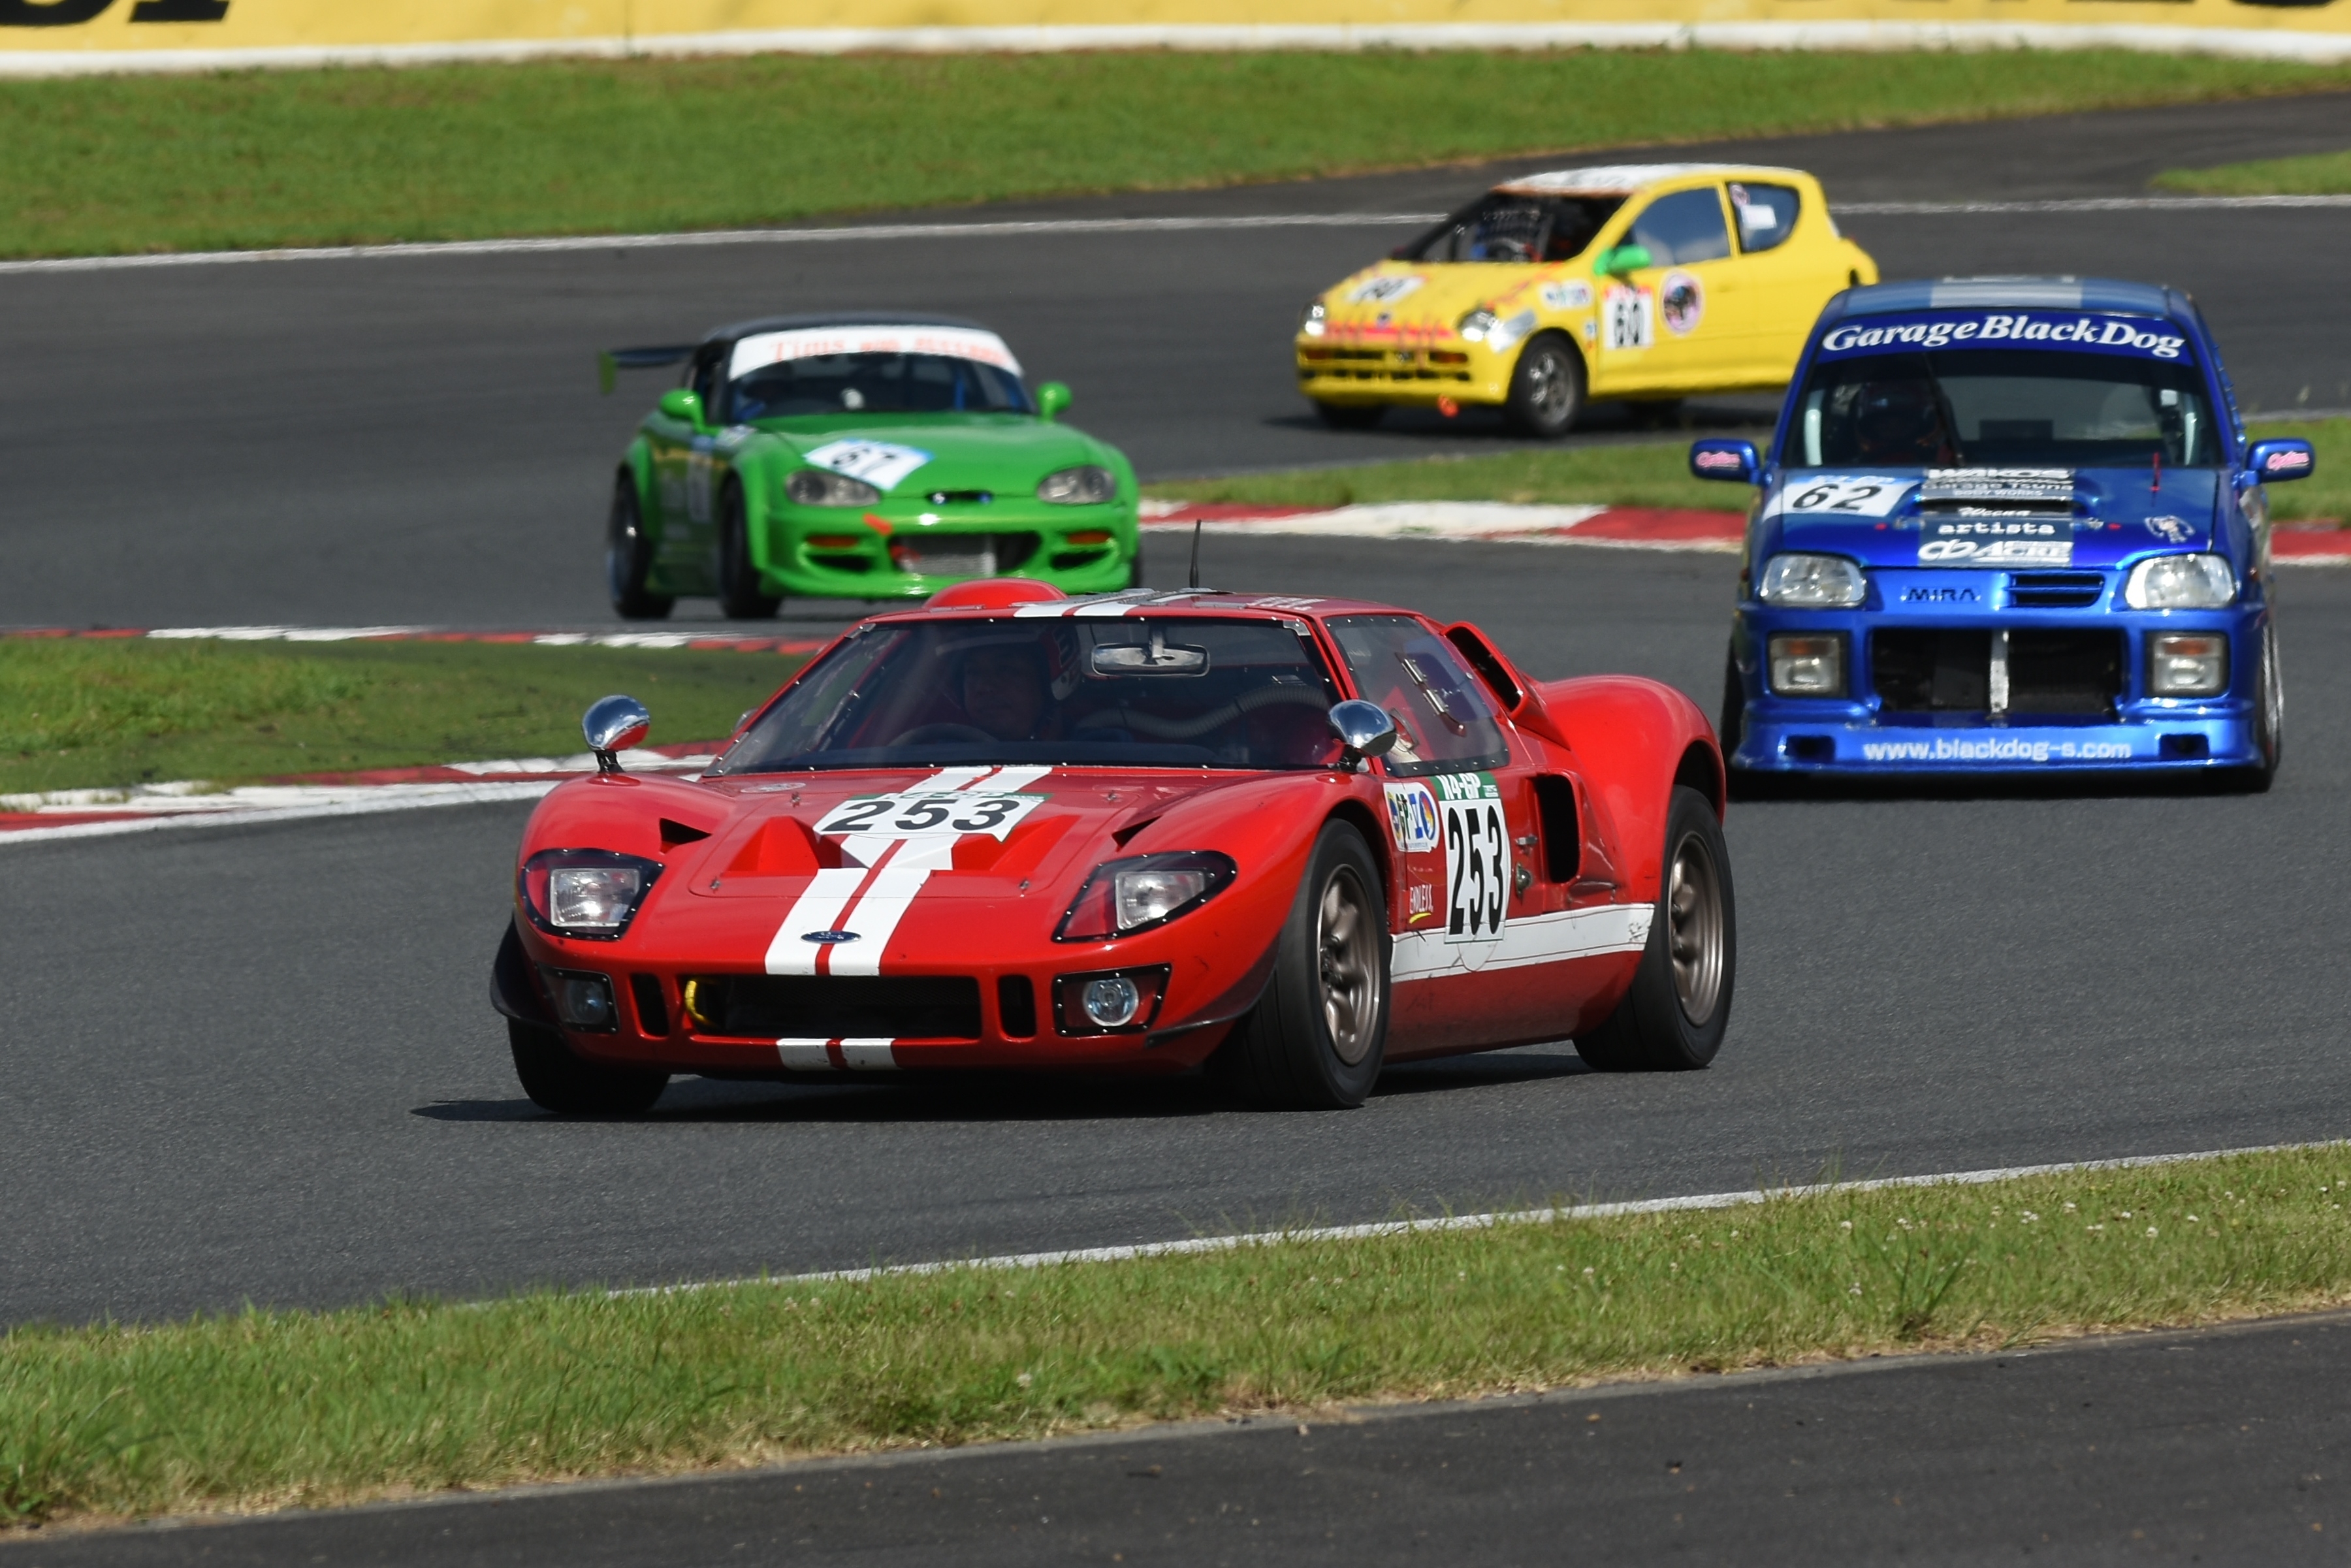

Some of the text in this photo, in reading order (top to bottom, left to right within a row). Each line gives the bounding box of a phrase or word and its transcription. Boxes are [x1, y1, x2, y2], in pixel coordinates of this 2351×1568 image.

[1792, 483, 1883, 510] 62
[1937, 522, 2056, 535] artista
[1906, 588, 1979, 601] MIRA
[1863, 738, 2132, 762] www.blackdog-s.com
[822, 799, 1020, 831] 253
[1448, 804, 1505, 936] 253
